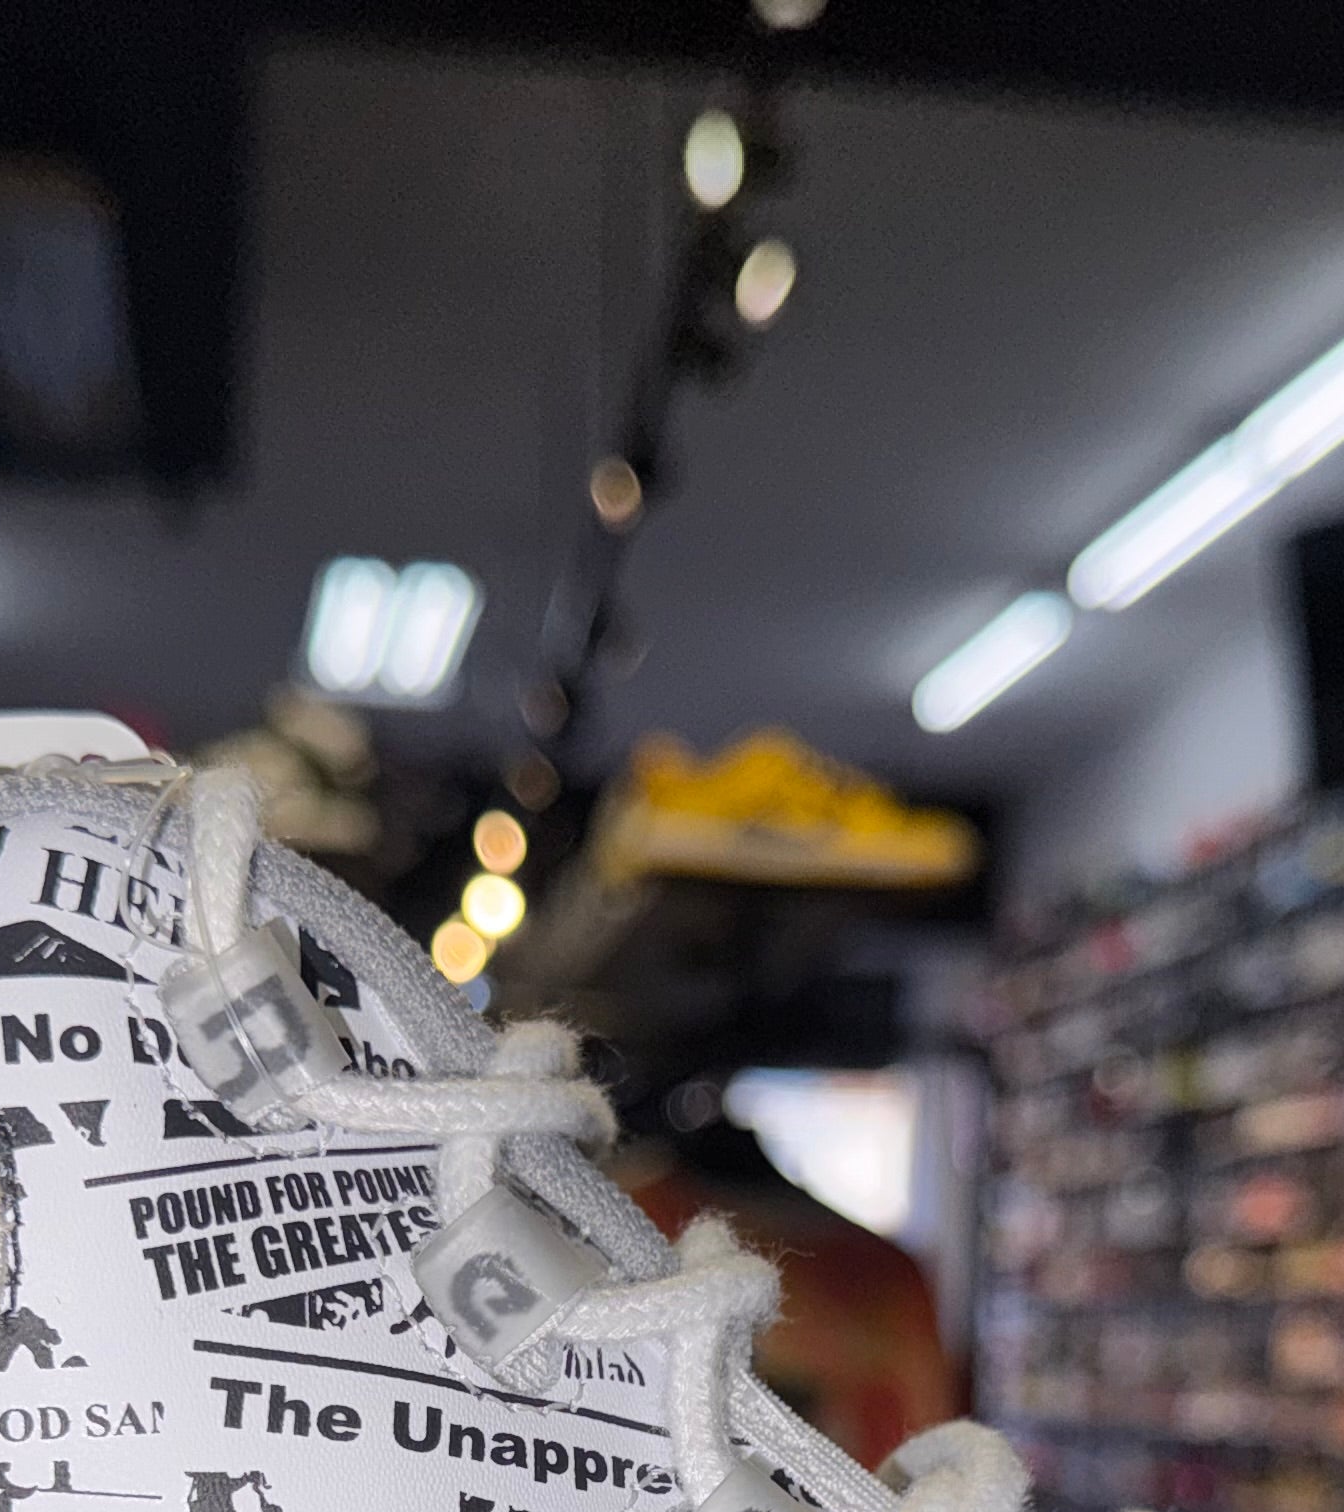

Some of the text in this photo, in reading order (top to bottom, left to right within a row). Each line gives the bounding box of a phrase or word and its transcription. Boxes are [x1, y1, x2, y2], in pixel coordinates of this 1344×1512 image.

[0, 1013, 102, 1065] No
[130, 1179, 261, 1240] POUND
[264, 1173, 333, 1220] FOR
[142, 1232, 245, 1300] THE
[209, 1375, 686, 1495] The Unappre
